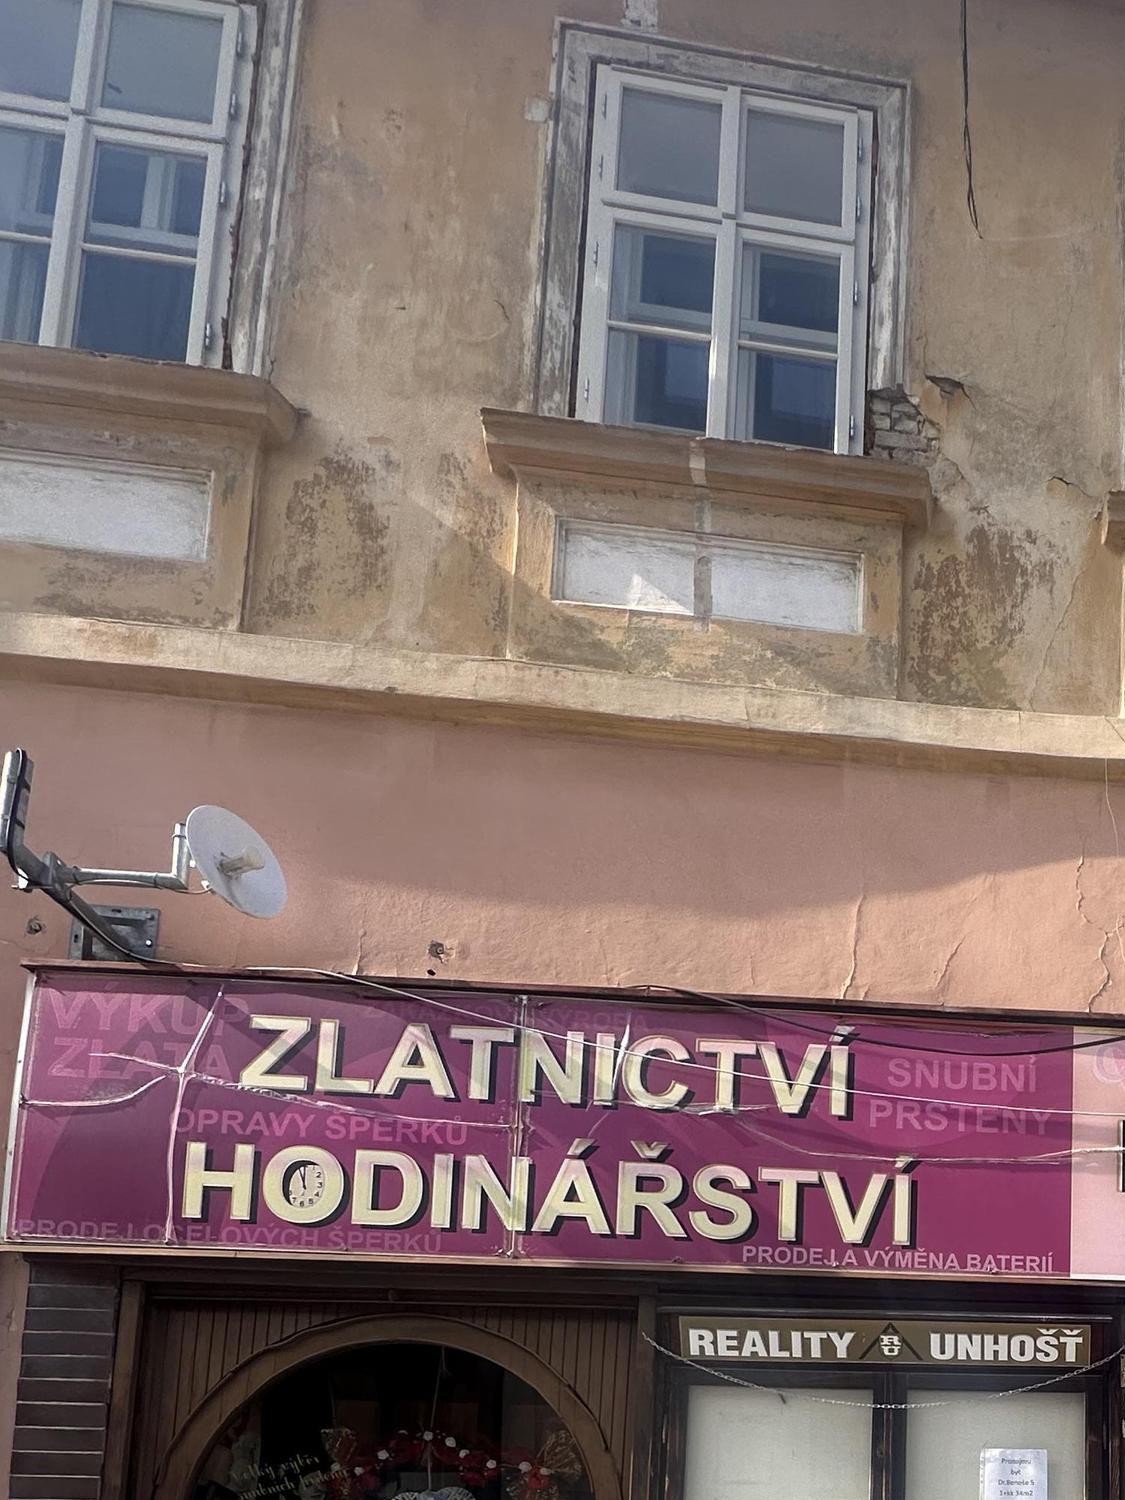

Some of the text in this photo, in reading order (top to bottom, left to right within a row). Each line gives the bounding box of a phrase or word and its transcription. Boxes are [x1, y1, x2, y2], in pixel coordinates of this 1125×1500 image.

[48, 982, 249, 1036] VÝKUP
[47, 1036, 233, 1080] ZLATA
[238, 1014, 857, 1120] ZLATNICTVÍ
[887, 1053, 1037, 1093] SNUBNÍ
[170, 1106, 469, 1147] OPRAVY ŠPERKŮ
[869, 1099, 1053, 1136] PRSTENY
[181, 1138, 917, 1248] HODINÁŘSTVÍ
[742, 1245, 1055, 1275] PRODEJ A VÝMĚNA BATERIÍ
[687, 1327, 1084, 1363] REALITY UNHOŠŤ
